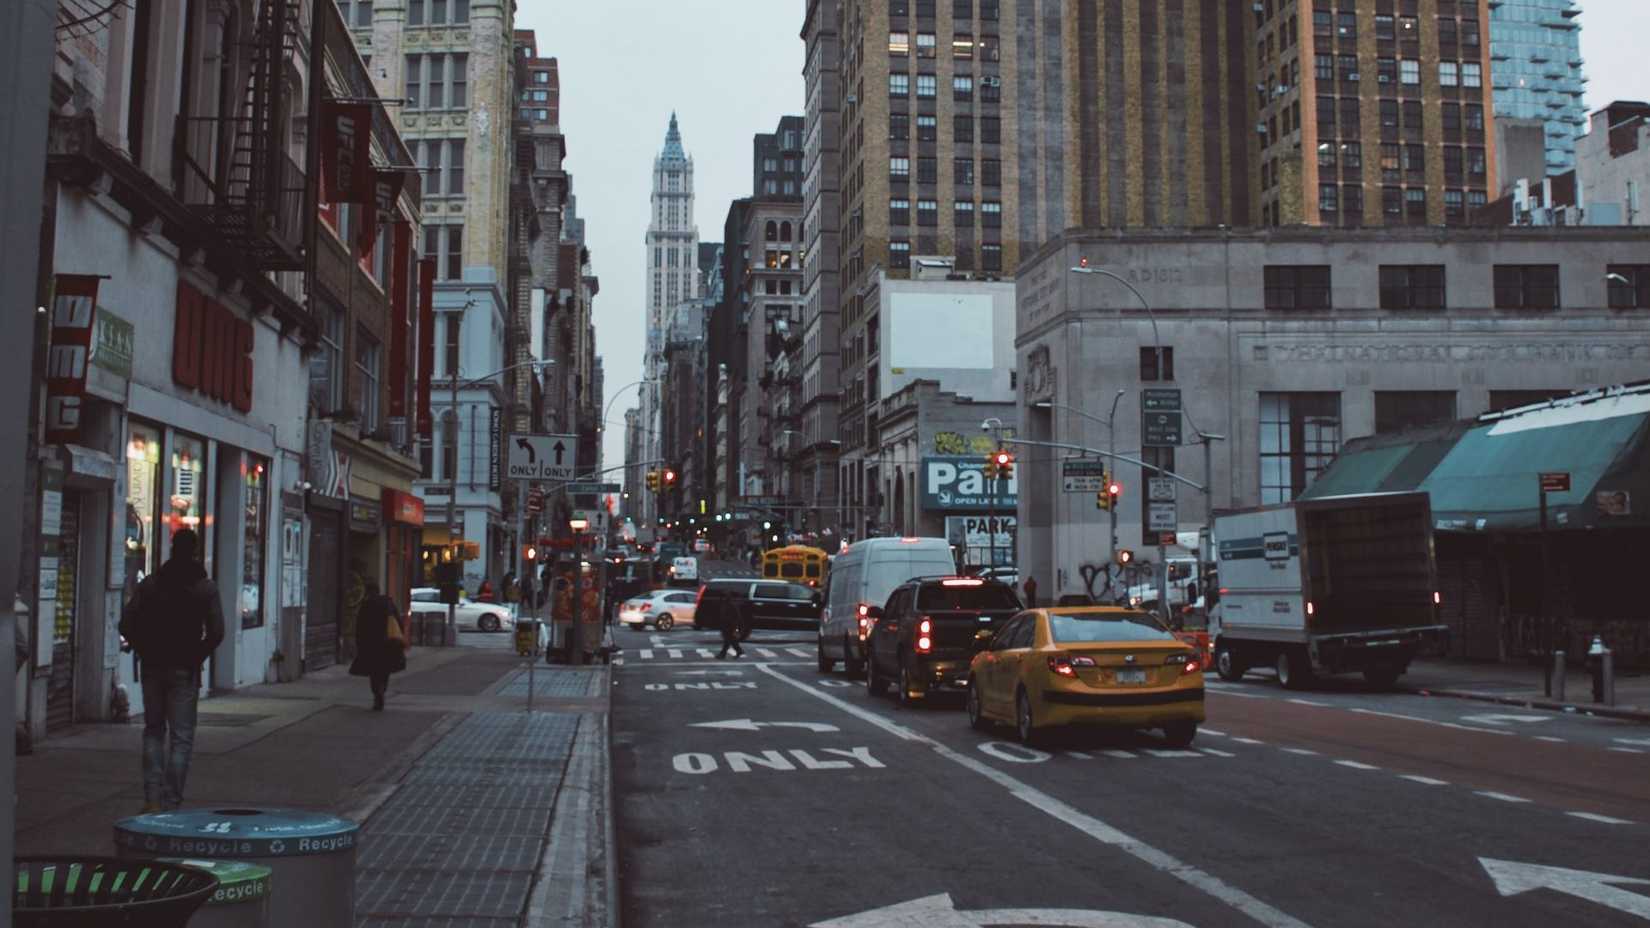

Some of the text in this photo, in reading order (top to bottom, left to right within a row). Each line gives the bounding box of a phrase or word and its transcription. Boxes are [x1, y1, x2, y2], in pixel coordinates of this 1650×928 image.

[510, 465, 537, 476] ONLY
[544, 468, 571, 477] ONLY
[644, 682, 758, 691] ONLY
[672, 747, 887, 774] ONLY
[168, 834, 353, 855] Recycle Recycle
[208, 880, 264, 902] ecycle
